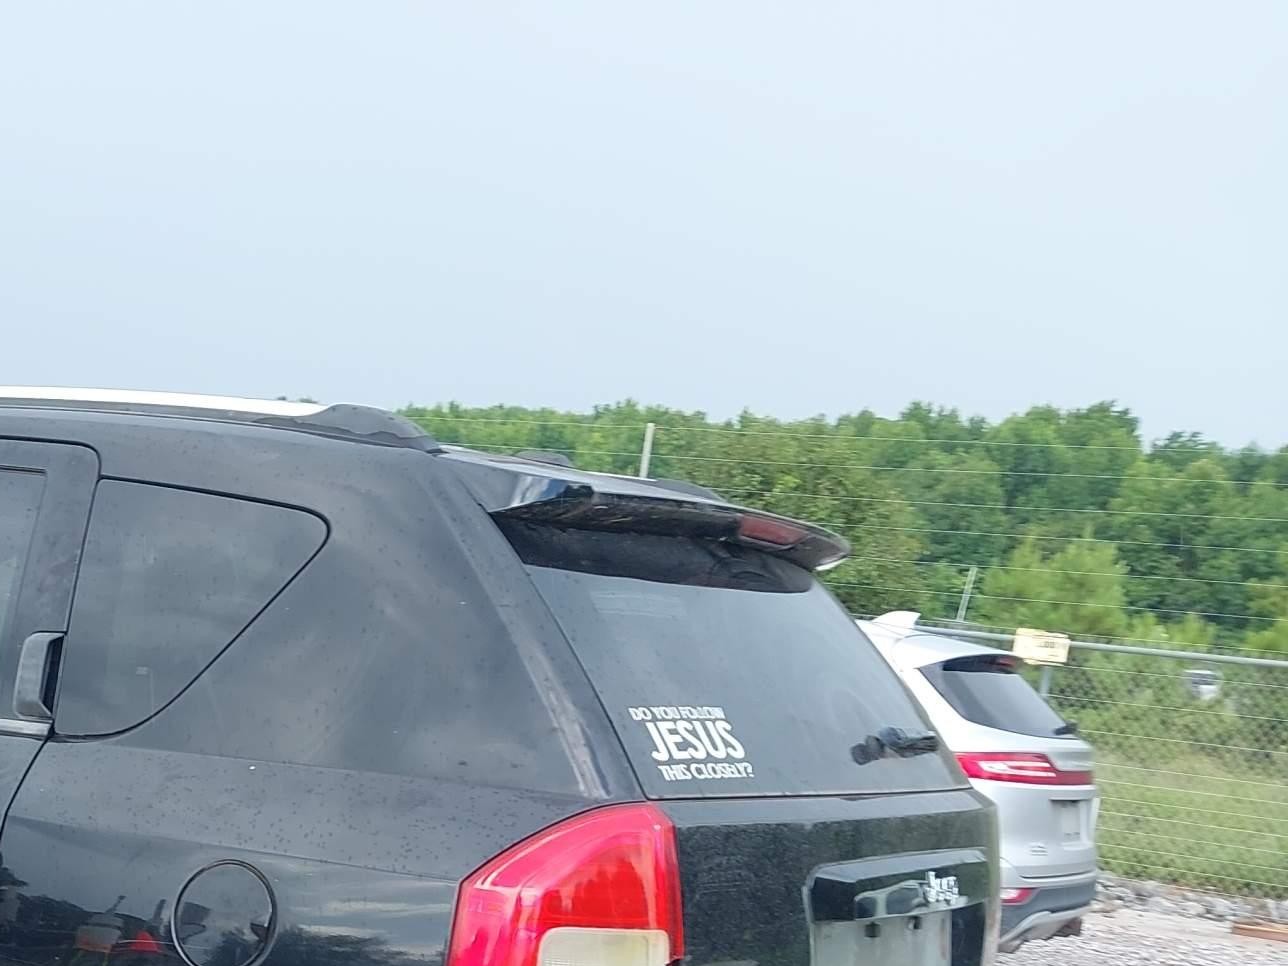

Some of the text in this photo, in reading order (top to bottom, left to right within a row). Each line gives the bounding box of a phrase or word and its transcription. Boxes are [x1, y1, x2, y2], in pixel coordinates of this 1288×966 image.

[628, 706, 726, 721] DO YOU FOLLOW
[645, 720, 745, 761] JESUS
[657, 762, 755, 781] THIS CLOSELY?
